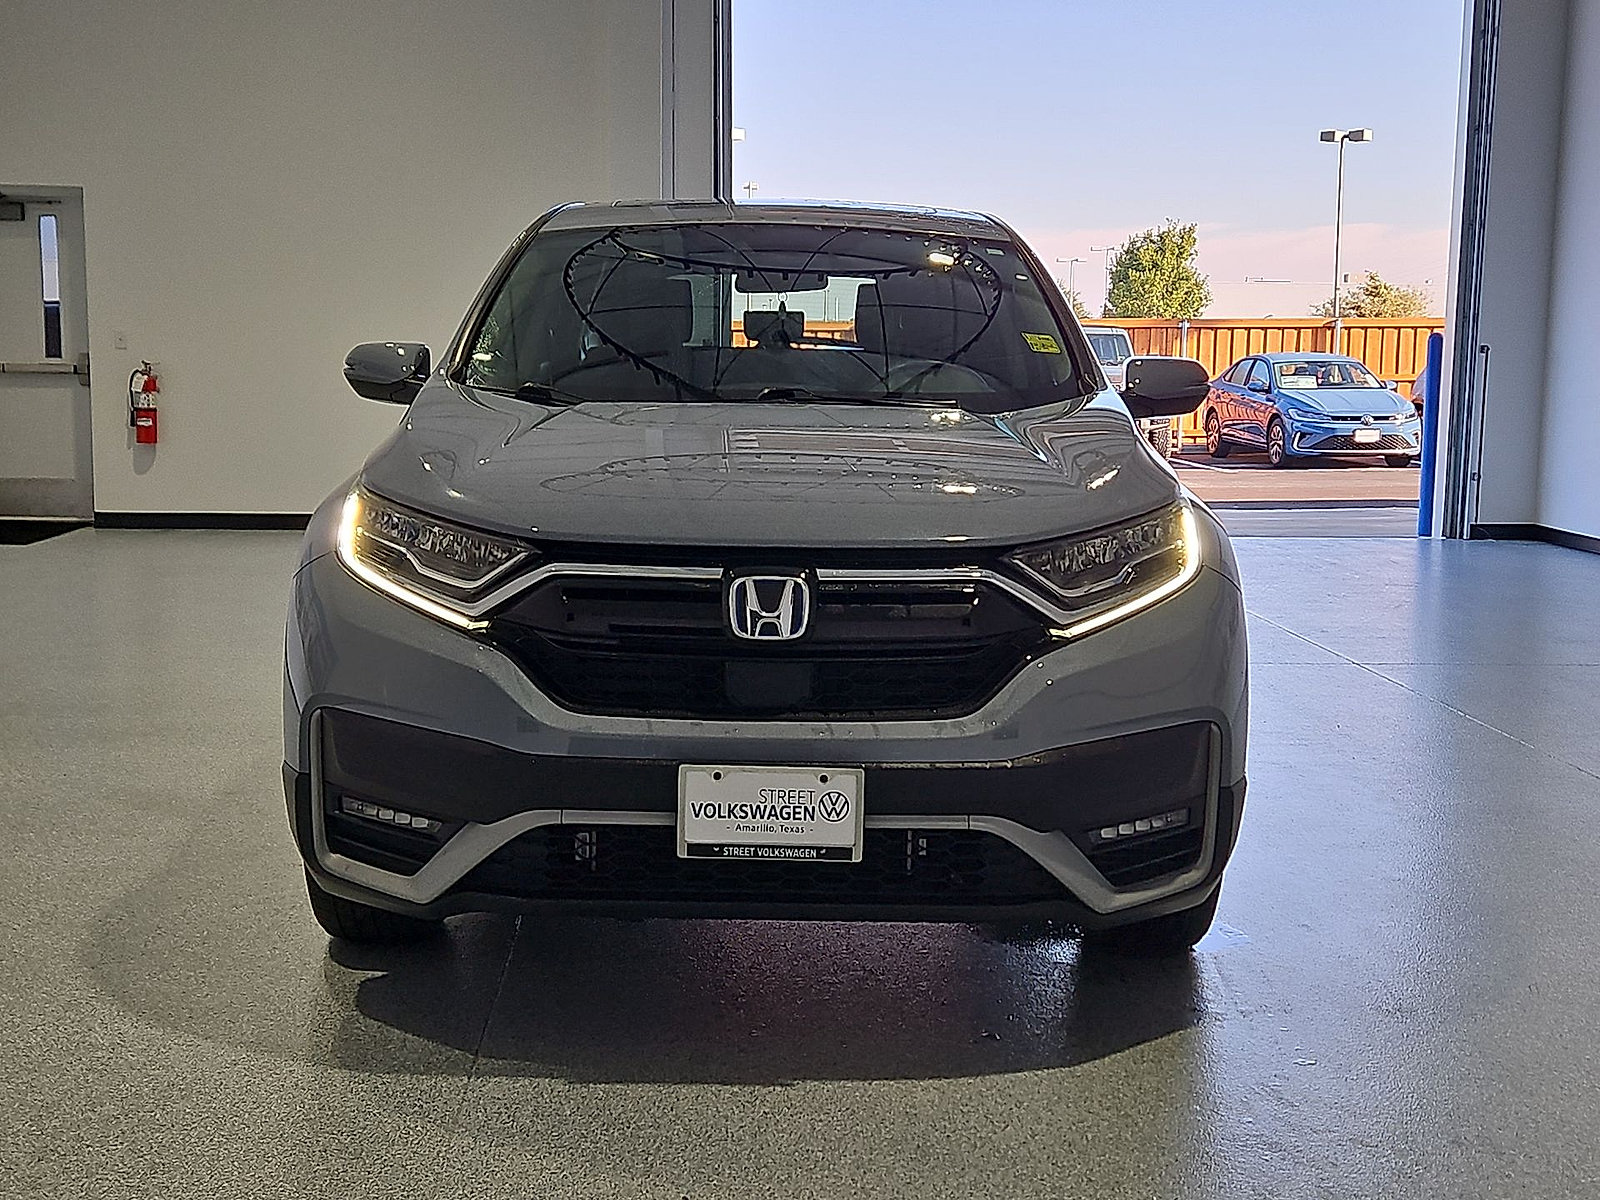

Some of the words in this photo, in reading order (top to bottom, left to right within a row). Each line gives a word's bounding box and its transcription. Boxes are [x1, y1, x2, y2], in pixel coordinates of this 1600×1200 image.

[758, 789, 815, 805] STREET
[691, 802, 815, 821] VOLKSWAGEN
[735, 823, 777, 834] Amarillo,
[779, 824, 805, 834] Texas
[723, 846, 756, 857] STREET
[757, 847, 817, 858] VOLKSWAGEN
